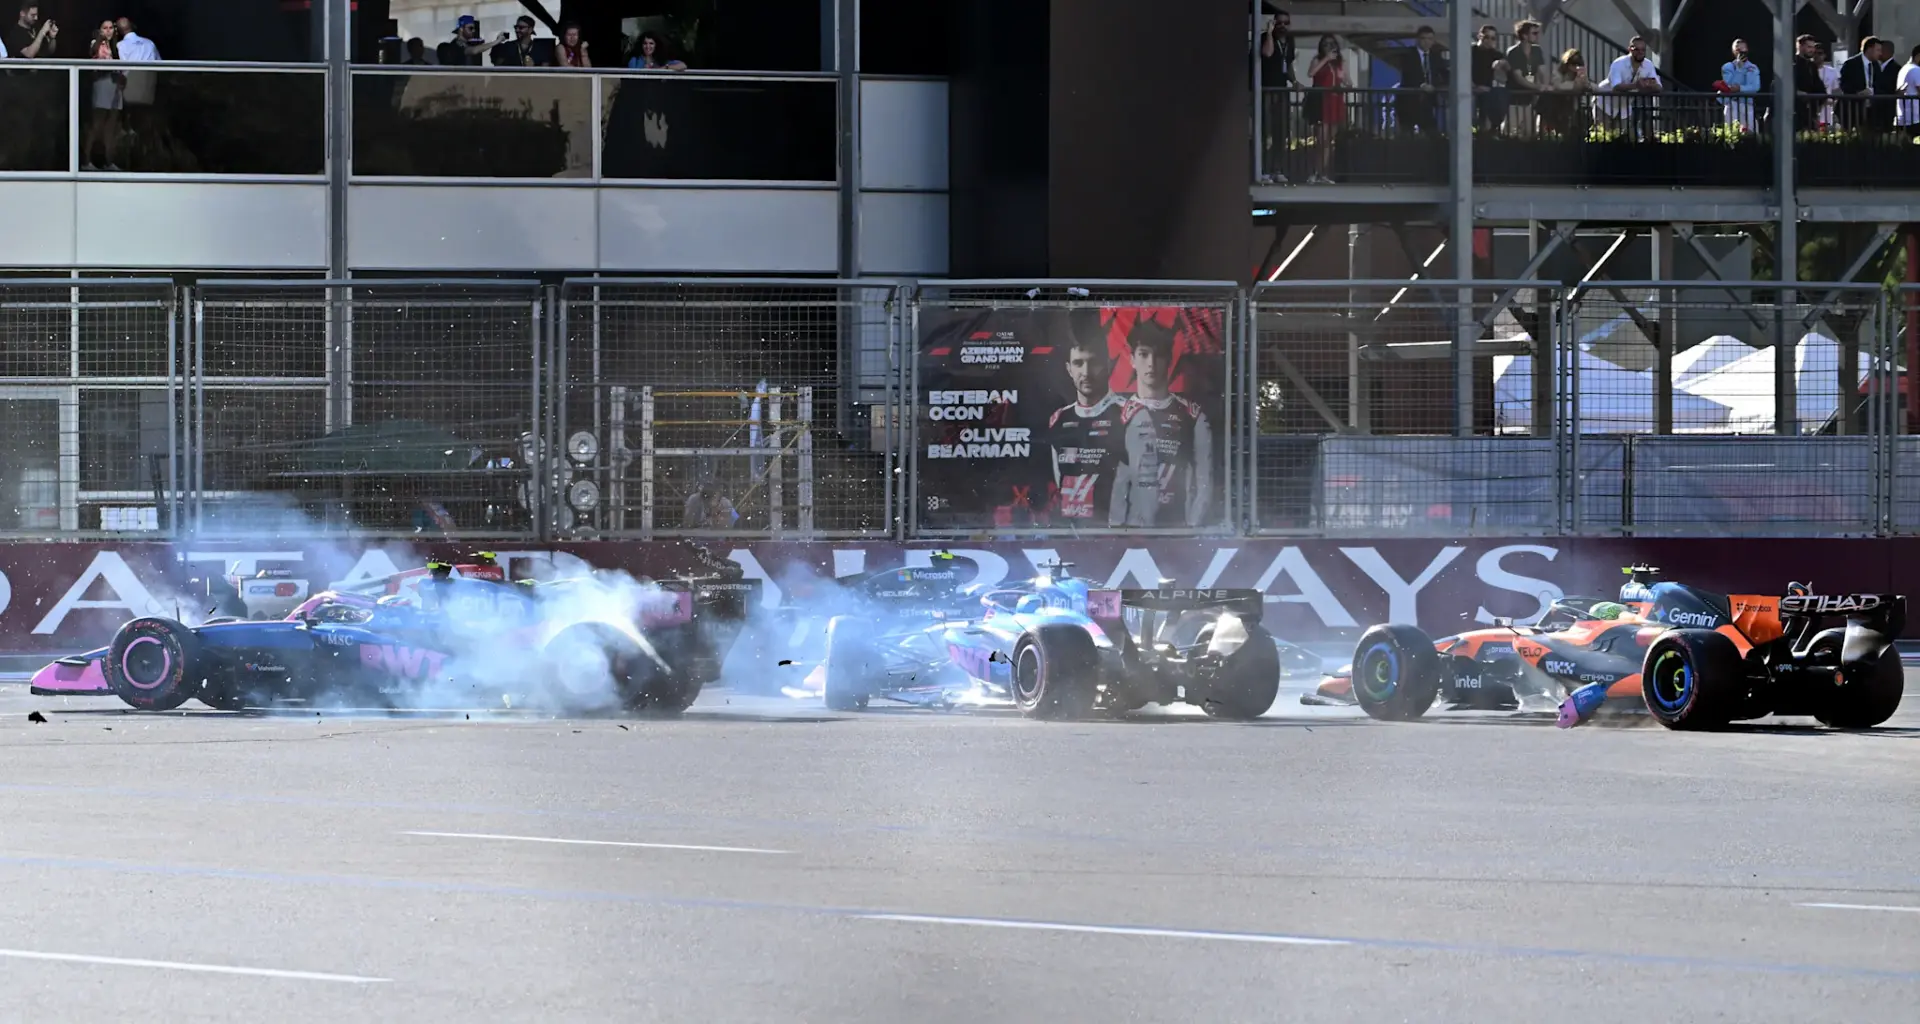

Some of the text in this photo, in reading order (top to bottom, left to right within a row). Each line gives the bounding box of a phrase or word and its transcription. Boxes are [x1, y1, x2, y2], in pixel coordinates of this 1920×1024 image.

[961, 347, 1024, 355] AZERBAIJAN
[961, 355, 998, 363] GRAND
[929, 390, 1018, 404] ESTEBAN
[929, 406, 984, 421] OCON
[960, 428, 1031, 442] OLIVER
[928, 444, 1030, 458] BEARMAN
[913, 571, 954, 579] Microsoft
[1141, 590, 1227, 599] ALPINE
[1782, 595, 1880, 612] ETIHAD
[1669, 607, 1718, 627] Gemini
[327, 634, 353, 646] MSC
[1545, 661, 1576, 674] OKX
[1455, 675, 1481, 688] intel
